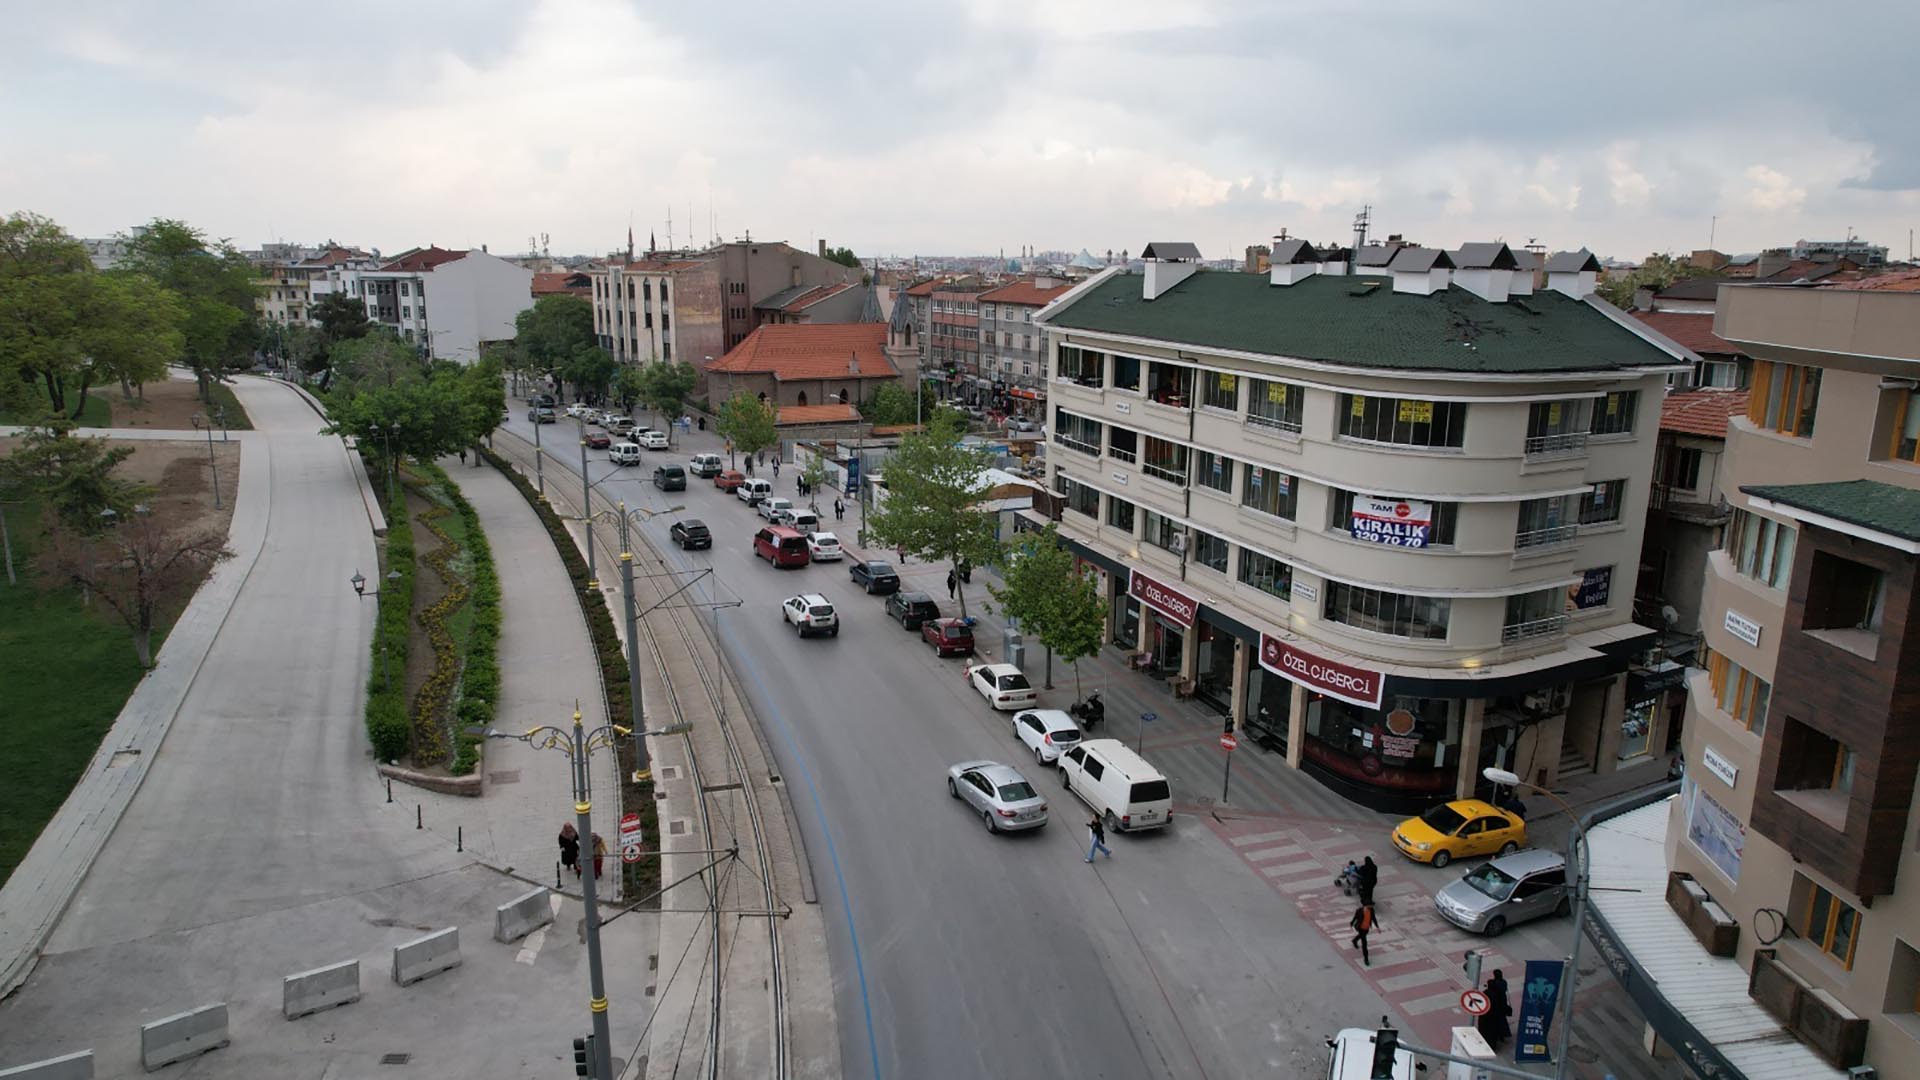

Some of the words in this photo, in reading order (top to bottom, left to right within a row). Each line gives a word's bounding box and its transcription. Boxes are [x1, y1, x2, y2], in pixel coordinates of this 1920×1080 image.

[1370, 503, 1393, 513] TAM
[1354, 517, 1424, 538] KİRALIK
[1355, 529, 1380, 542] 320
[1383, 534, 1401, 545] 70
[1405, 537, 1422, 548] 70
[1283, 650, 1310, 676] ÖZEL
[1310, 664, 1371, 694] CİĞERCİ
